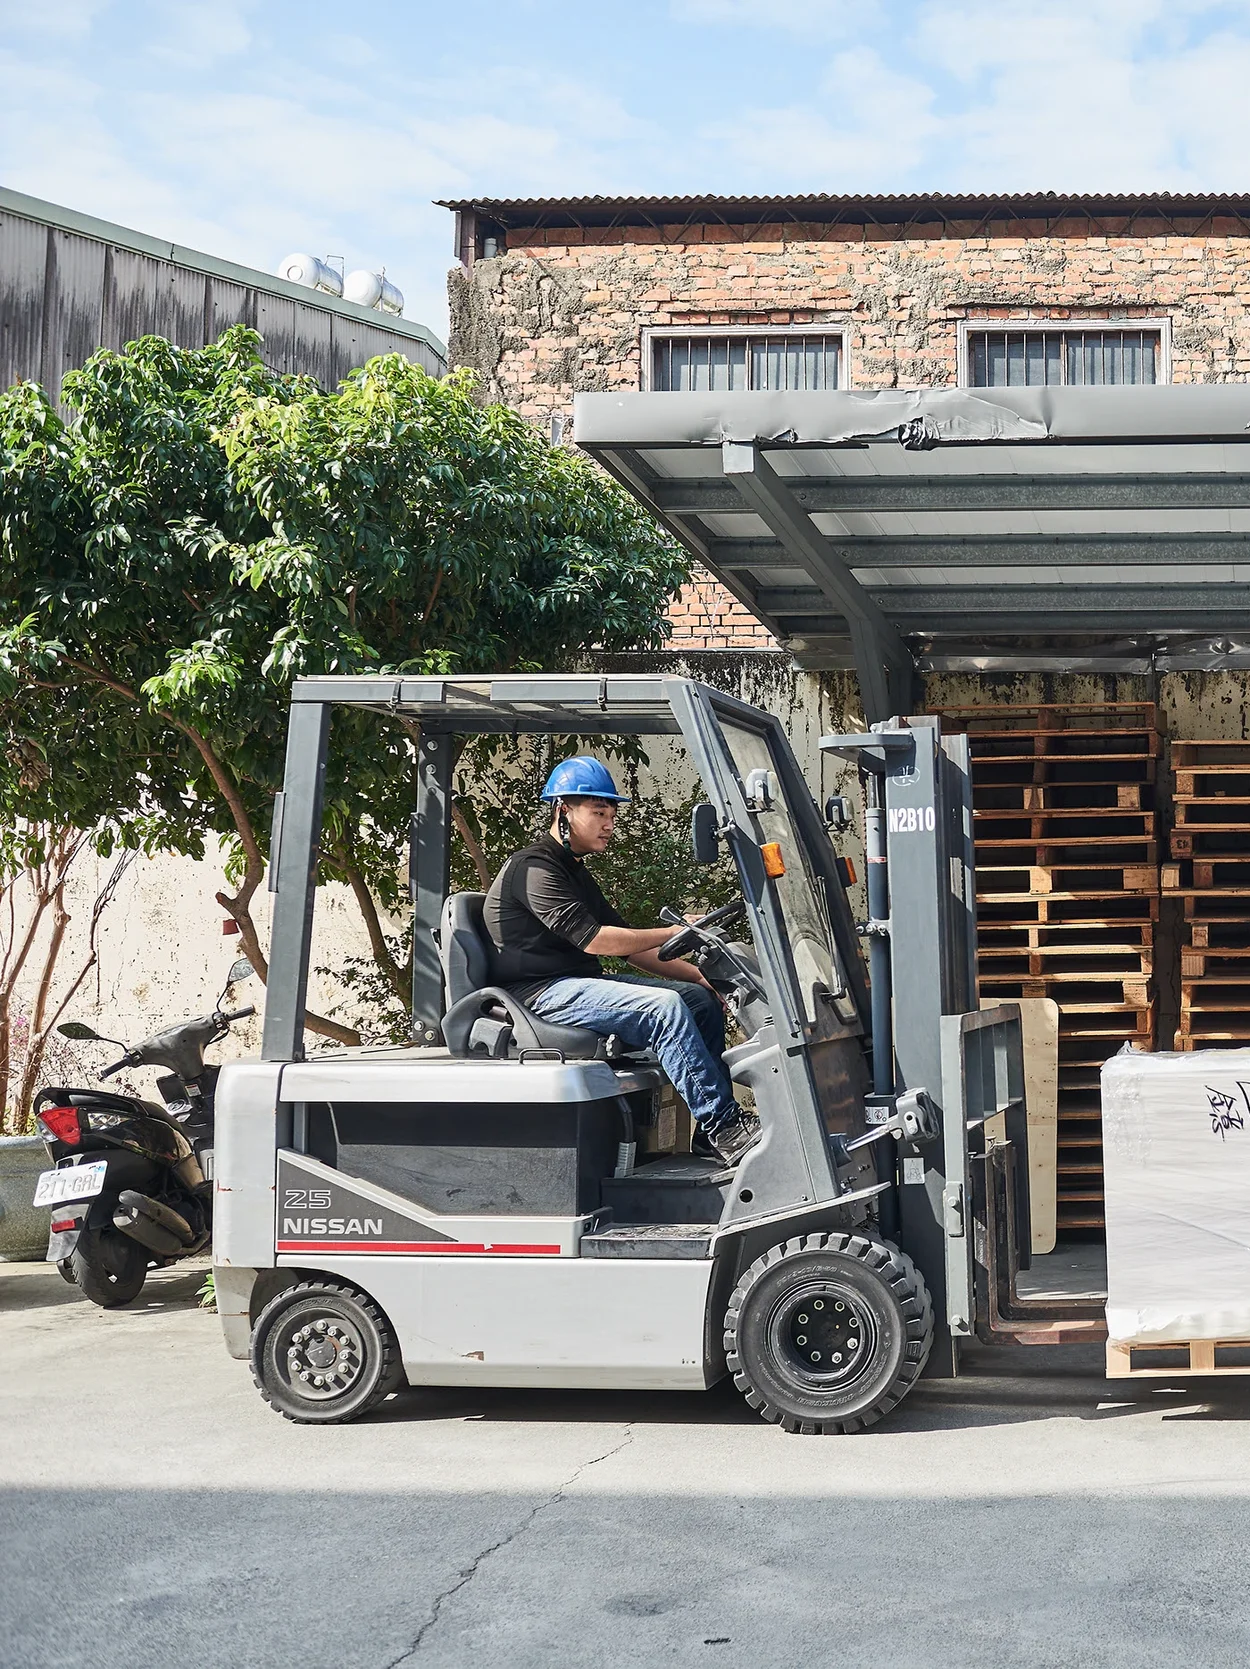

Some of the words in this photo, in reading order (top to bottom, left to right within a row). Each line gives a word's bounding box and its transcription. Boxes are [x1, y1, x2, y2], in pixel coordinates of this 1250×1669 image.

[889, 807, 935, 833] N2B10
[284, 1189, 331, 1209] 25
[283, 1218, 383, 1235] NISSAN
